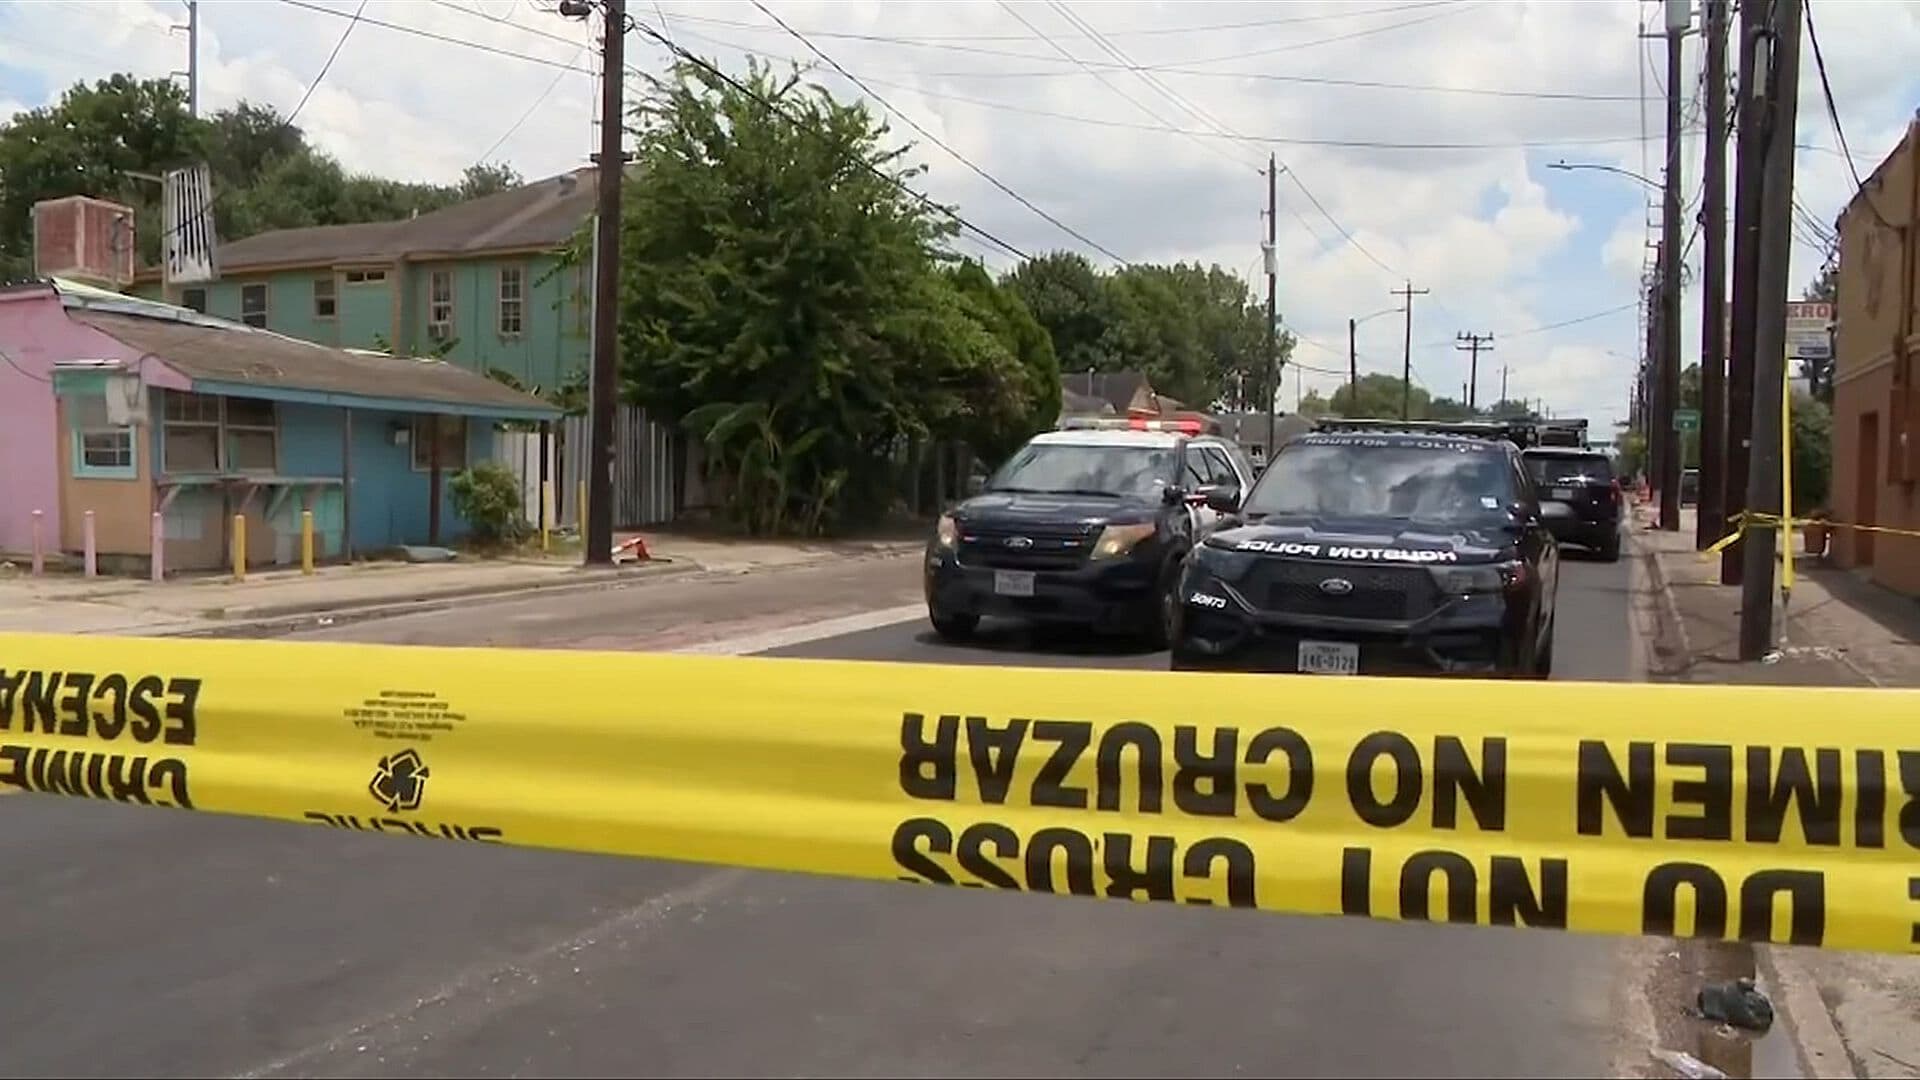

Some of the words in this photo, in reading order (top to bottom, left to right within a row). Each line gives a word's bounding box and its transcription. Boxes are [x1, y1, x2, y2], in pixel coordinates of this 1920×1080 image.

[1305, 438, 1388, 446] HOUSTON
[1400, 440, 1484, 451] POLICE
[0, 668, 202, 746] ESCENA
[899, 712, 1314, 823] CRUZAR
[1346, 730, 1507, 831] NO
[891, 818, 1258, 910] CROSS
[1642, 861, 1825, 946] DO
